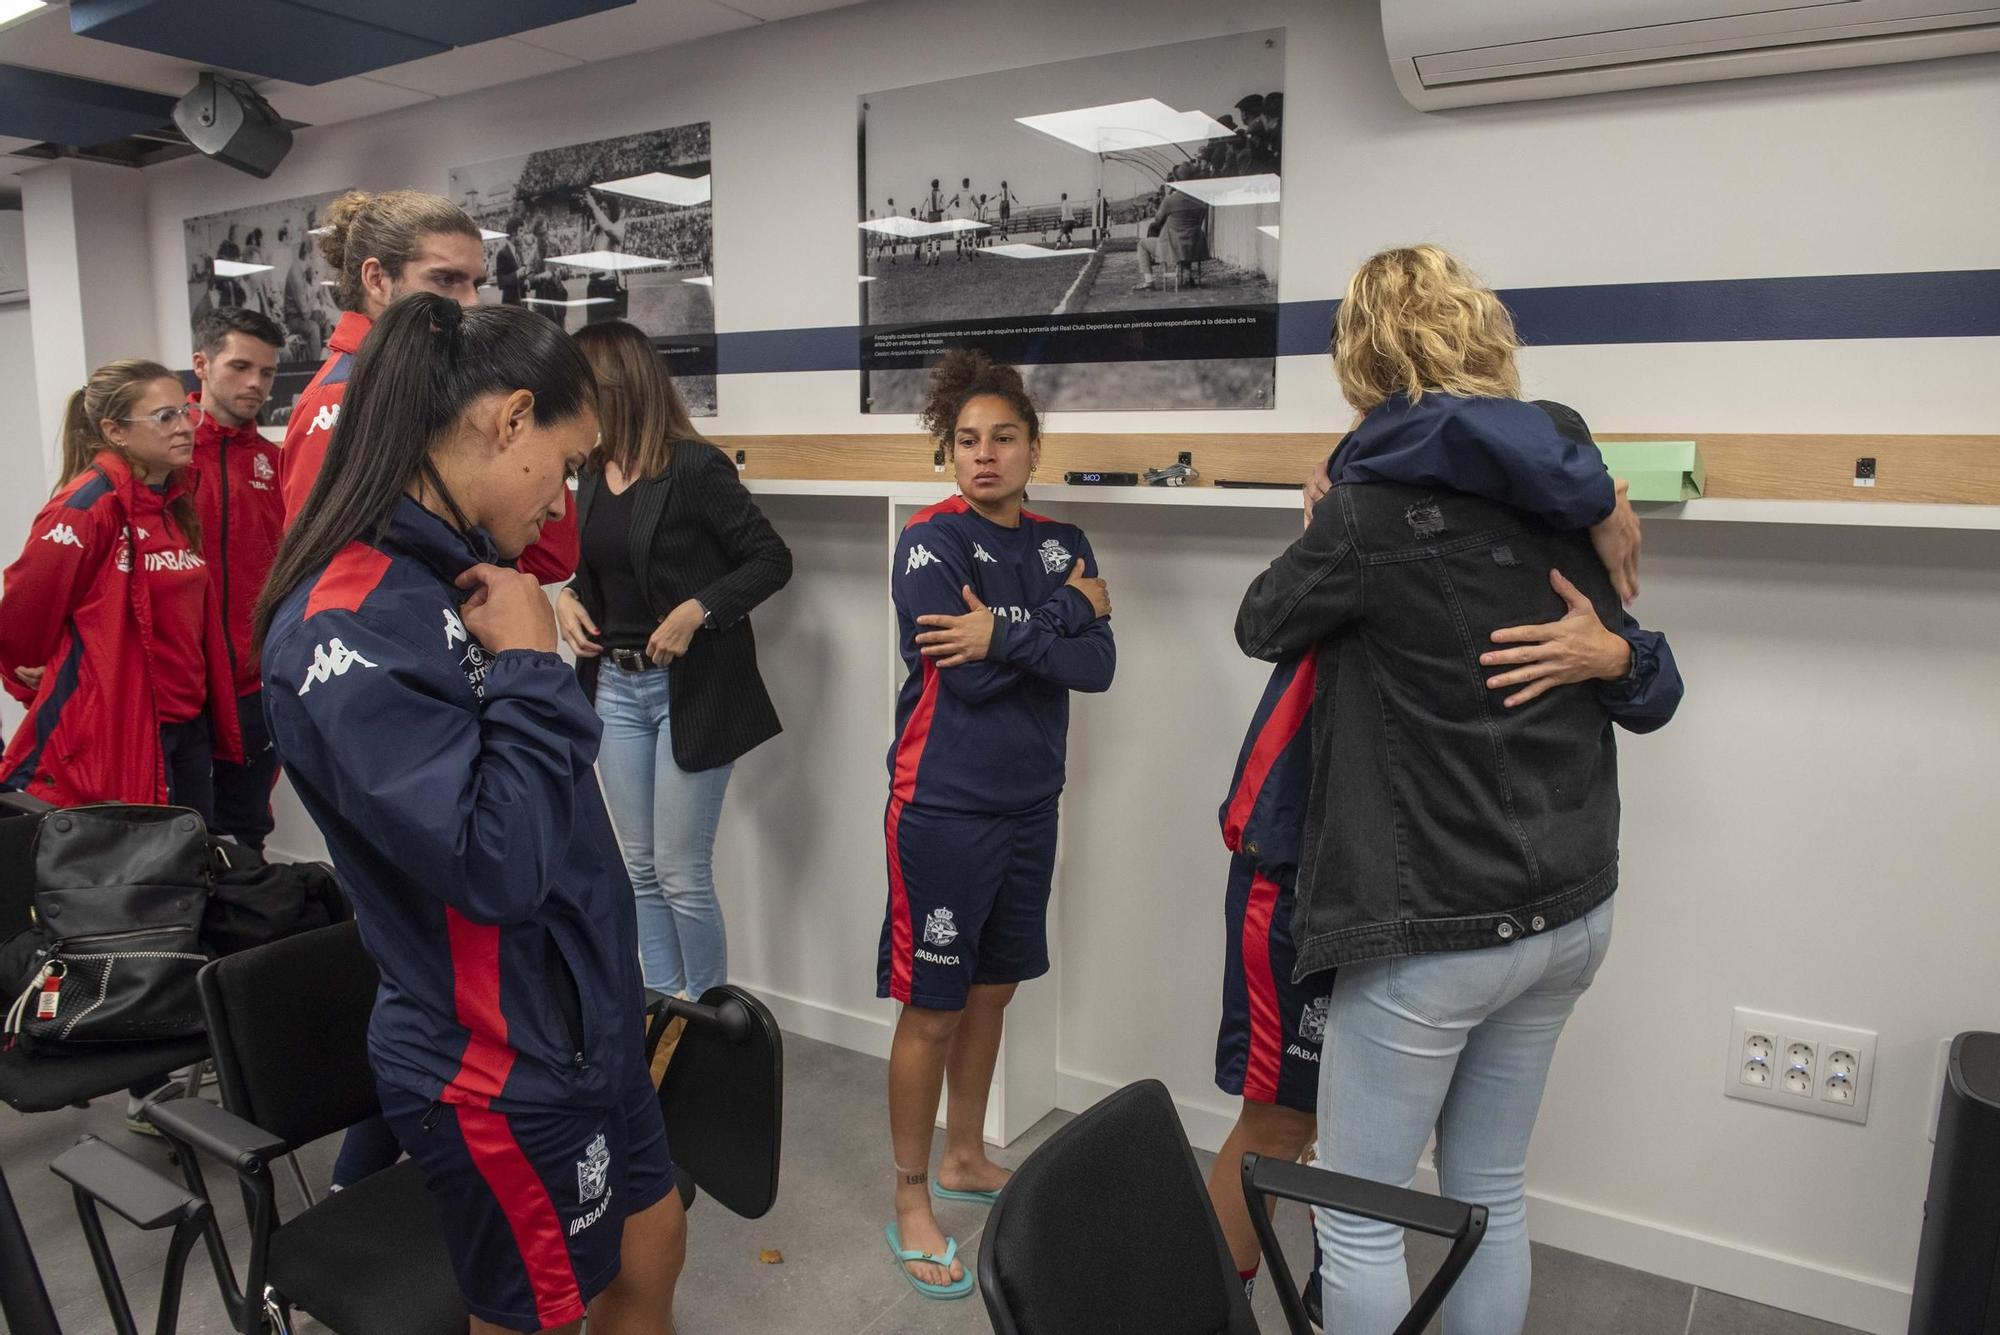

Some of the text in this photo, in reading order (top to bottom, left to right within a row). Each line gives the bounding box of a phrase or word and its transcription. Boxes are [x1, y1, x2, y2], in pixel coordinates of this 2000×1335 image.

[1131, 321, 1152, 329] partido
[1153, 319, 1201, 327] correspondiente
[1214, 317, 1236, 325] década
